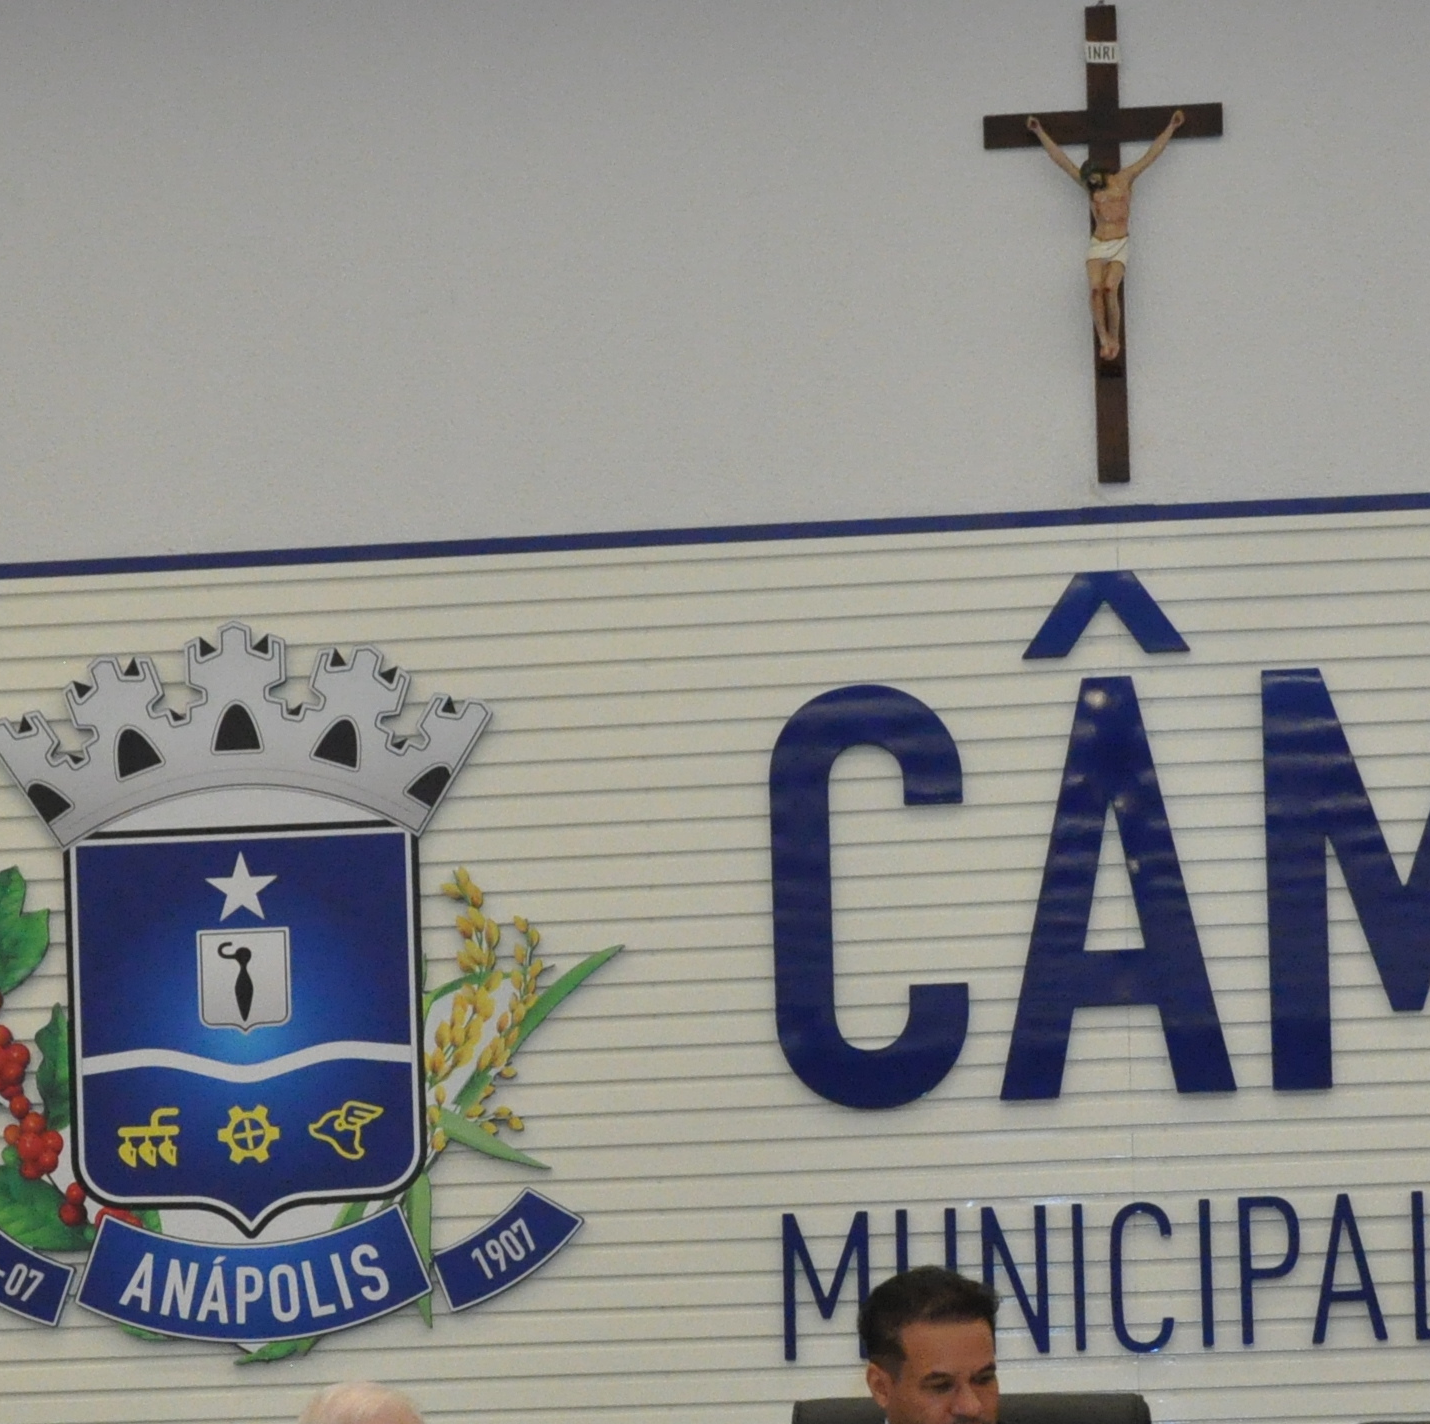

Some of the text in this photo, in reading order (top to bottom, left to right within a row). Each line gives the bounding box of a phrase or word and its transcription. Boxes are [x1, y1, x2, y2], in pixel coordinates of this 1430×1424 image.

[1088, 45, 1115, 60] INRI
[470, 1220, 535, 1281] 1907
[118, 1243, 390, 1326] ANÁPOLIS
